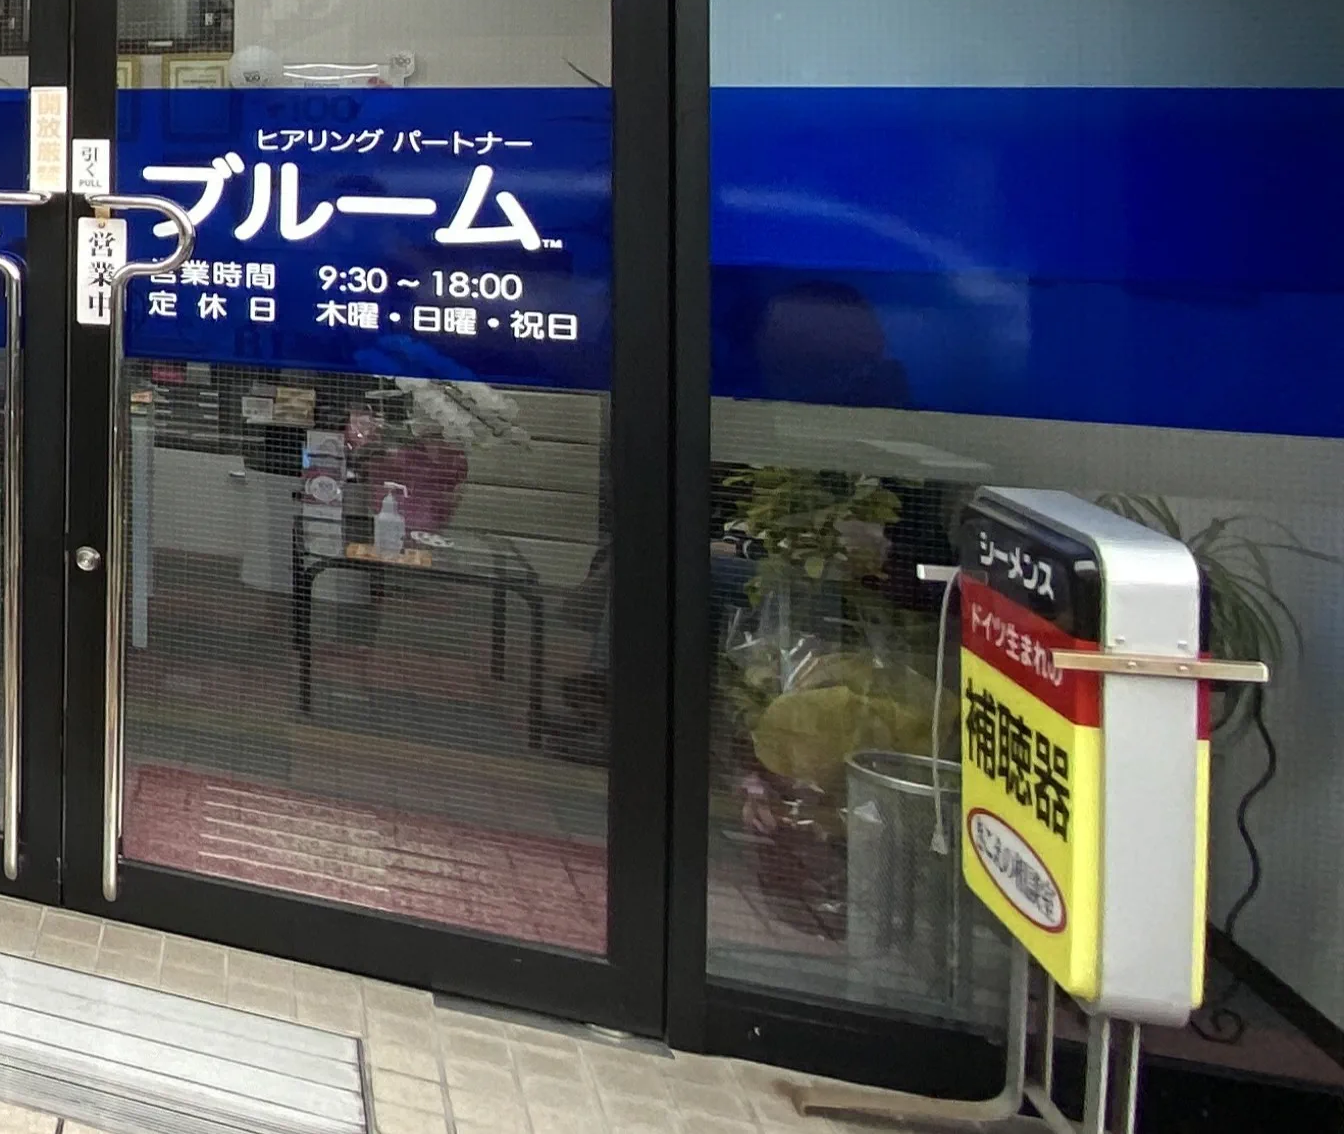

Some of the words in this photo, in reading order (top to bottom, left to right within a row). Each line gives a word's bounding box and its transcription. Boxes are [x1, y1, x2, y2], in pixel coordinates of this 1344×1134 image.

[81, 146, 99, 178] 引く
[257, 128, 385, 153] ヒアリング
[392, 130, 533, 155] パートナー
[79, 179, 102, 189] PULL
[142, 151, 542, 251] ブルーム
[88, 231, 116, 318] 営業中
[317, 265, 389, 294] 9:30
[431, 269, 523, 301] 18:00
[979, 530, 1056, 601] シーメンス
[965, 677, 1071, 843] 補聴器
